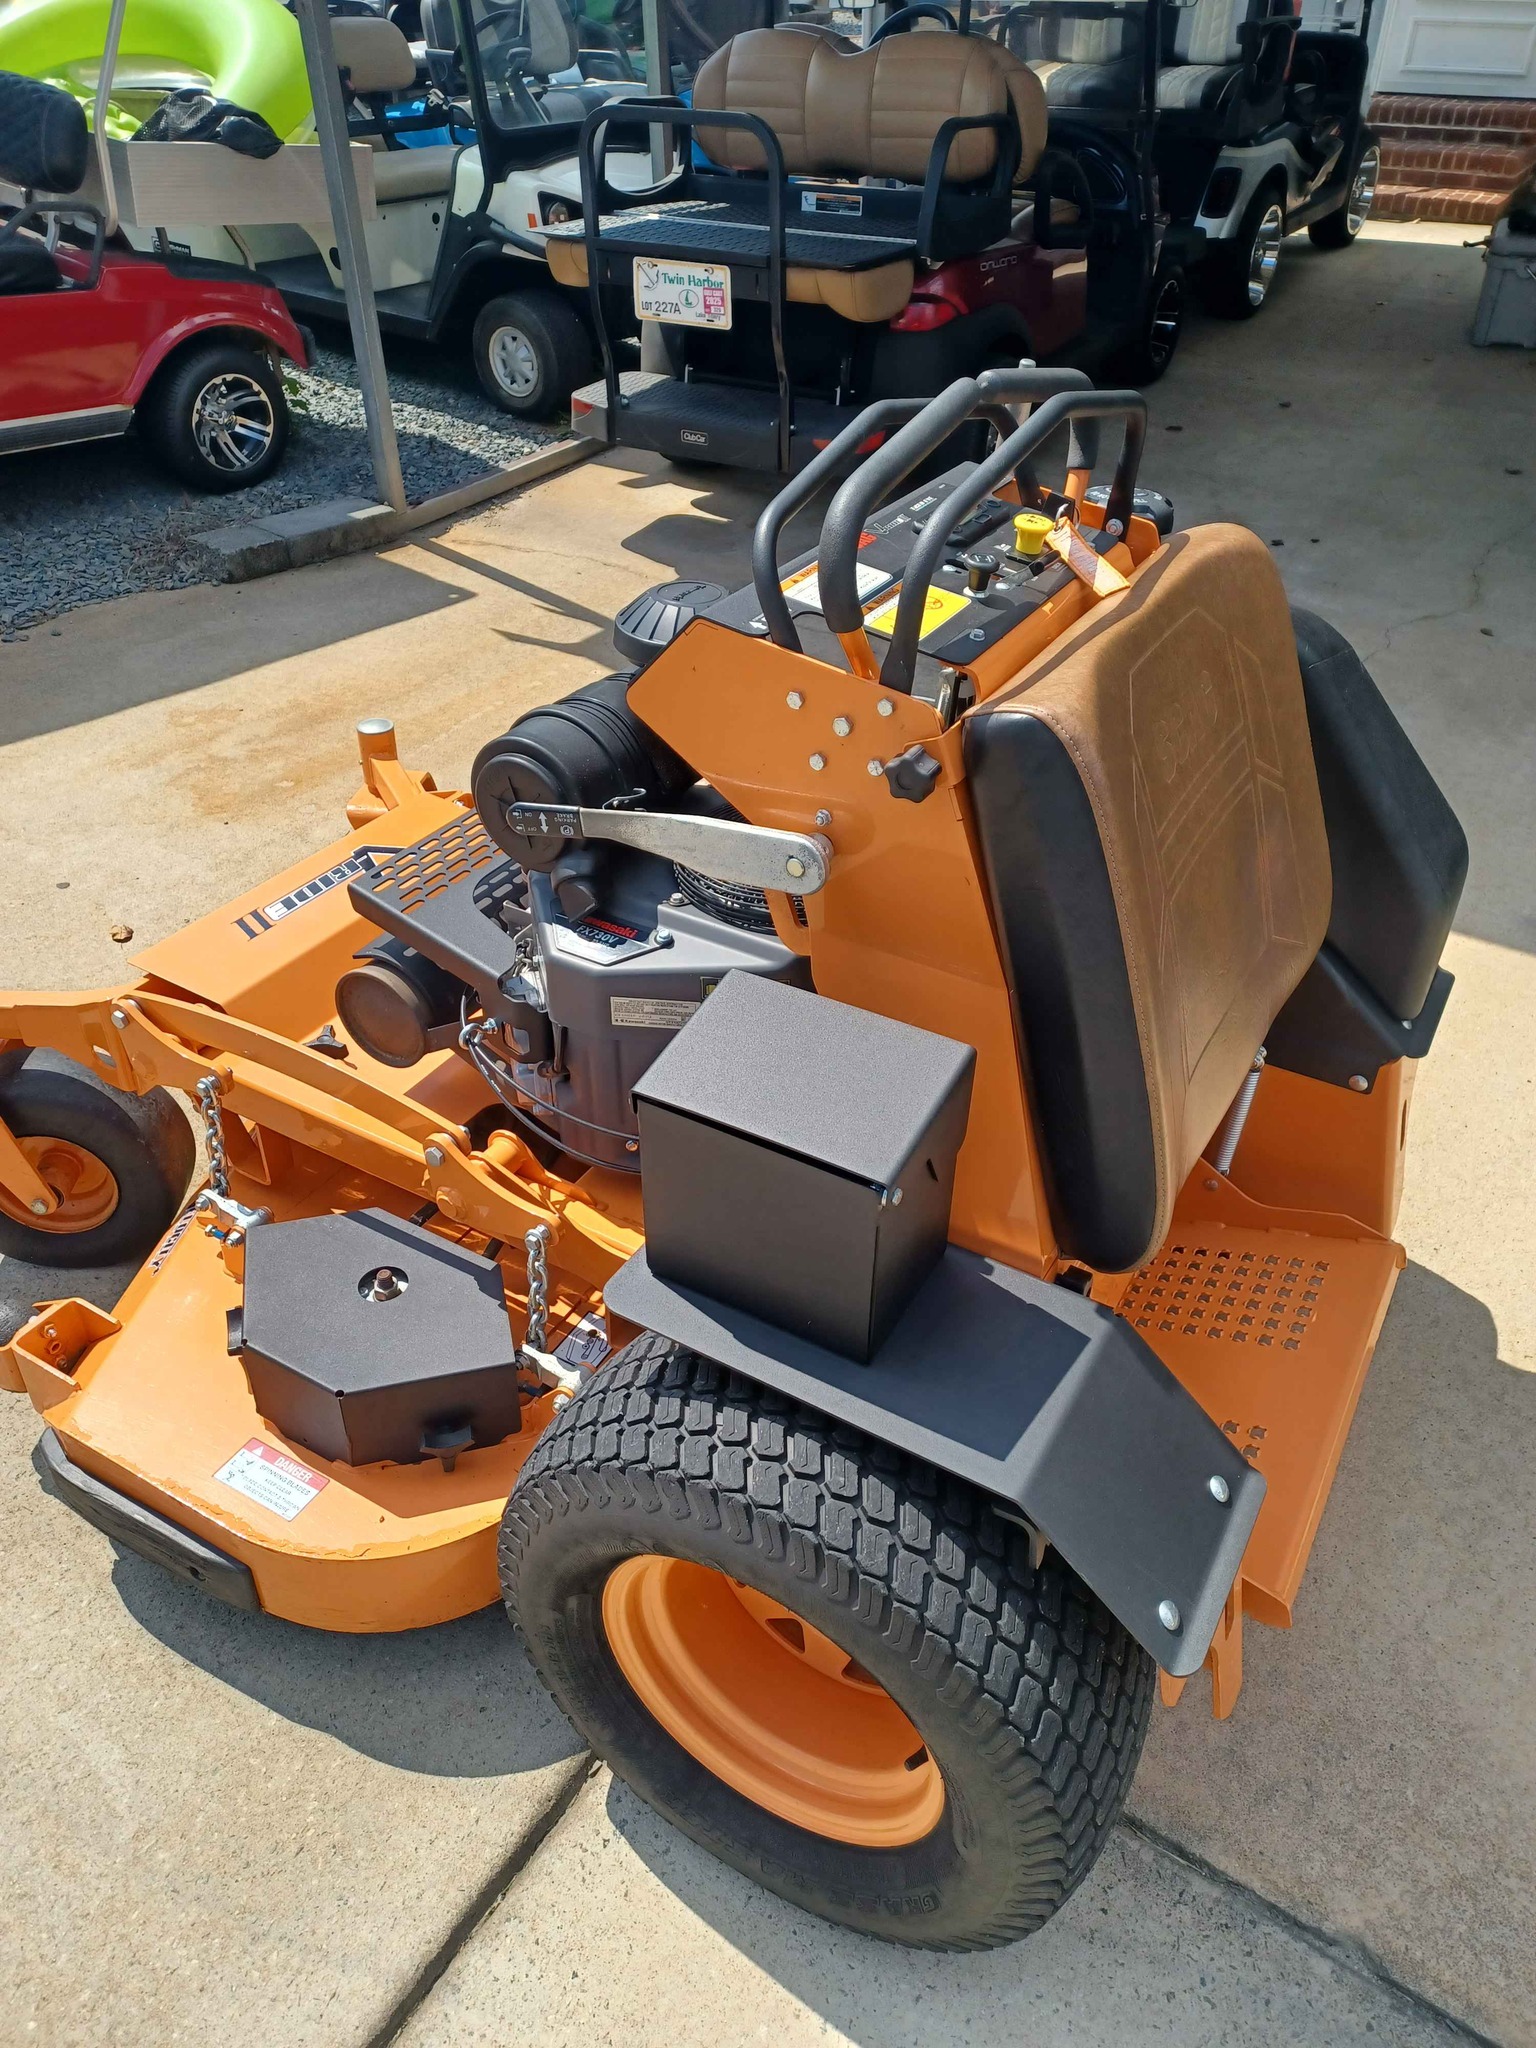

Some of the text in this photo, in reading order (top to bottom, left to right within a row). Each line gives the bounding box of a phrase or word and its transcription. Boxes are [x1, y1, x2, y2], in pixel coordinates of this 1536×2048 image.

[661, 272, 724, 289] Twin Harbor
[641, 300, 681, 315] LOT 227A
[576, 925, 619, 944] FX730V
[274, 1457, 313, 1483] DANGER
[259, 1465, 311, 1496] SPINNING BLADES
